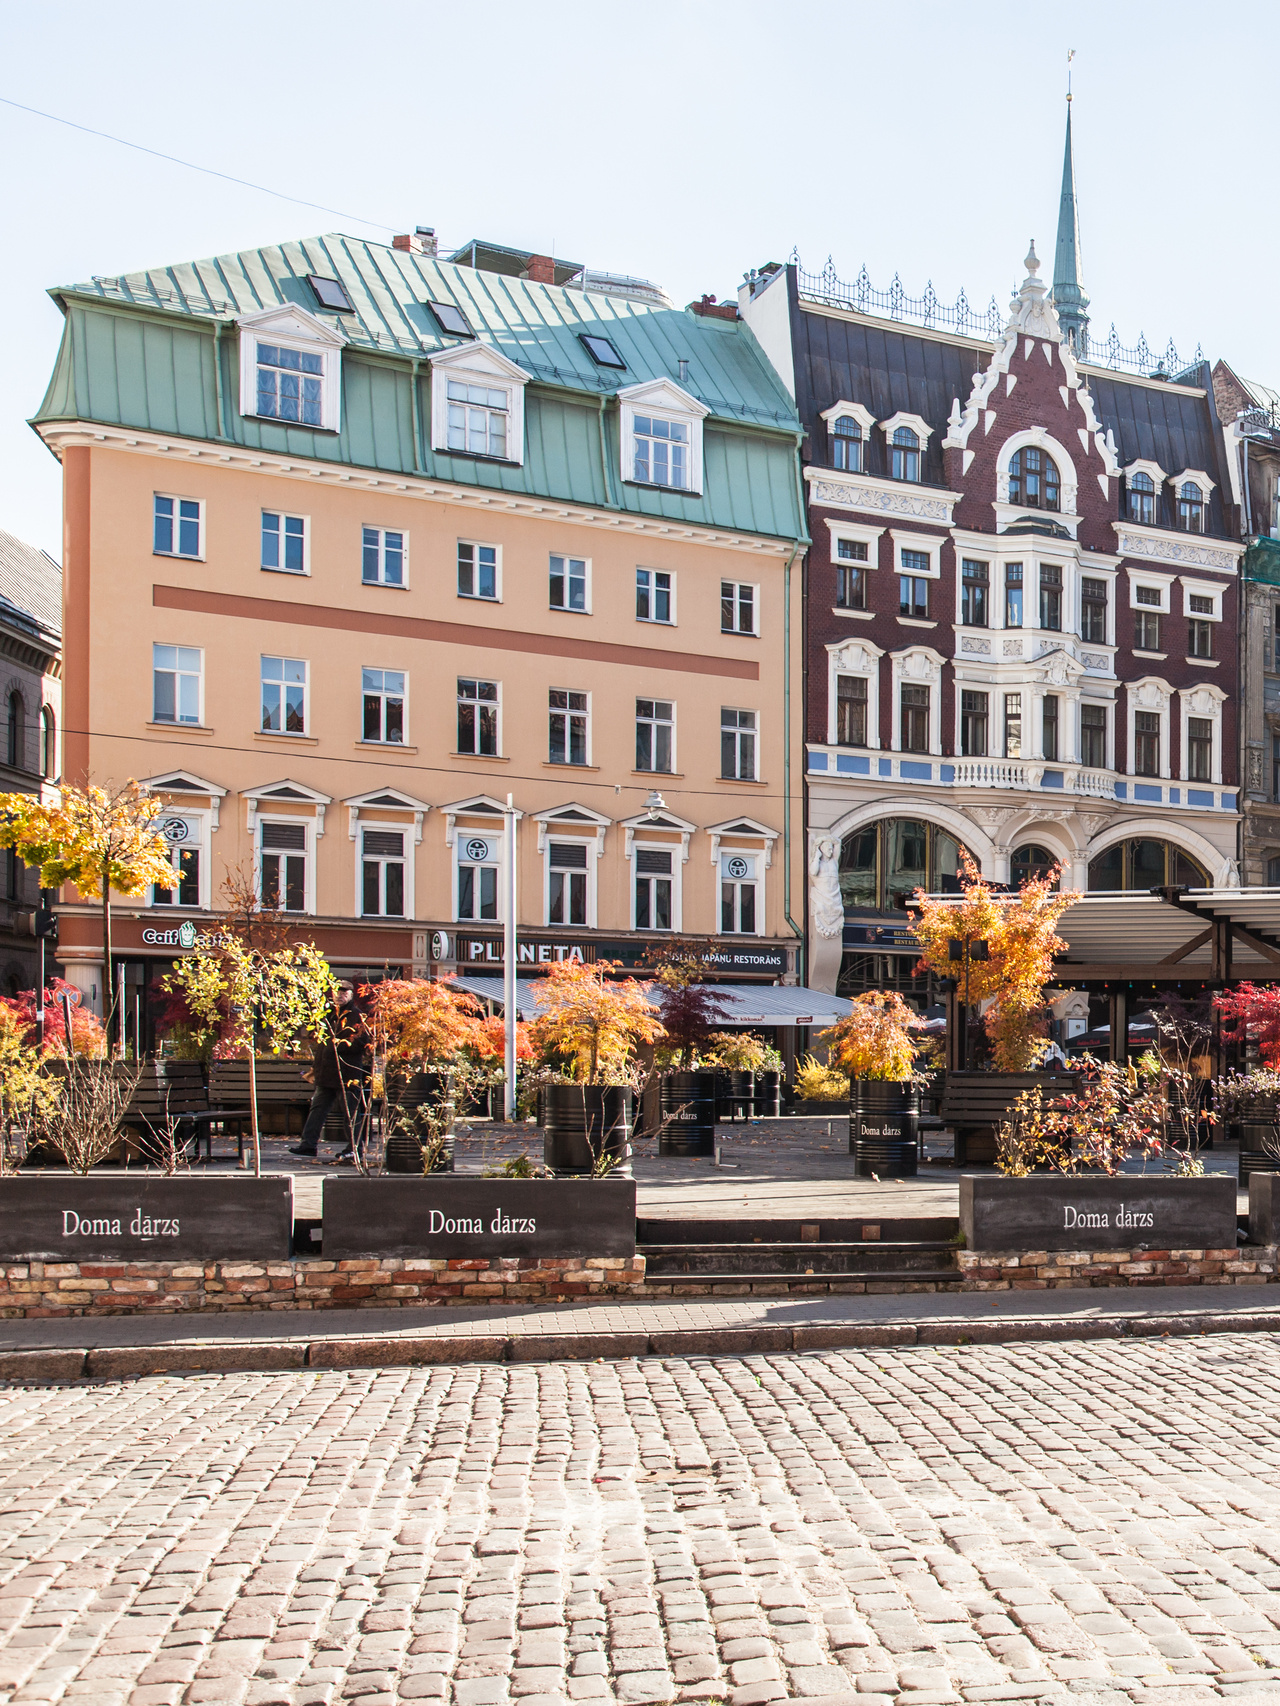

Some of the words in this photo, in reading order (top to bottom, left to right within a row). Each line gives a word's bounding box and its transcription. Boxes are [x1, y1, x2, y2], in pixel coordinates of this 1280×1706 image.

[142, 928, 179, 946] Caif
[733, 953, 781, 966] RESTORĀNS
[861, 1124, 881, 1136] Doma
[61, 1210, 123, 1237] Doma
[130, 1207, 180, 1237] dārzs
[428, 1209, 484, 1234] Doma
[490, 1207, 536, 1234] dārzs
[1063, 1205, 1110, 1229] Doma
[1115, 1203, 1154, 1229] dārzs
